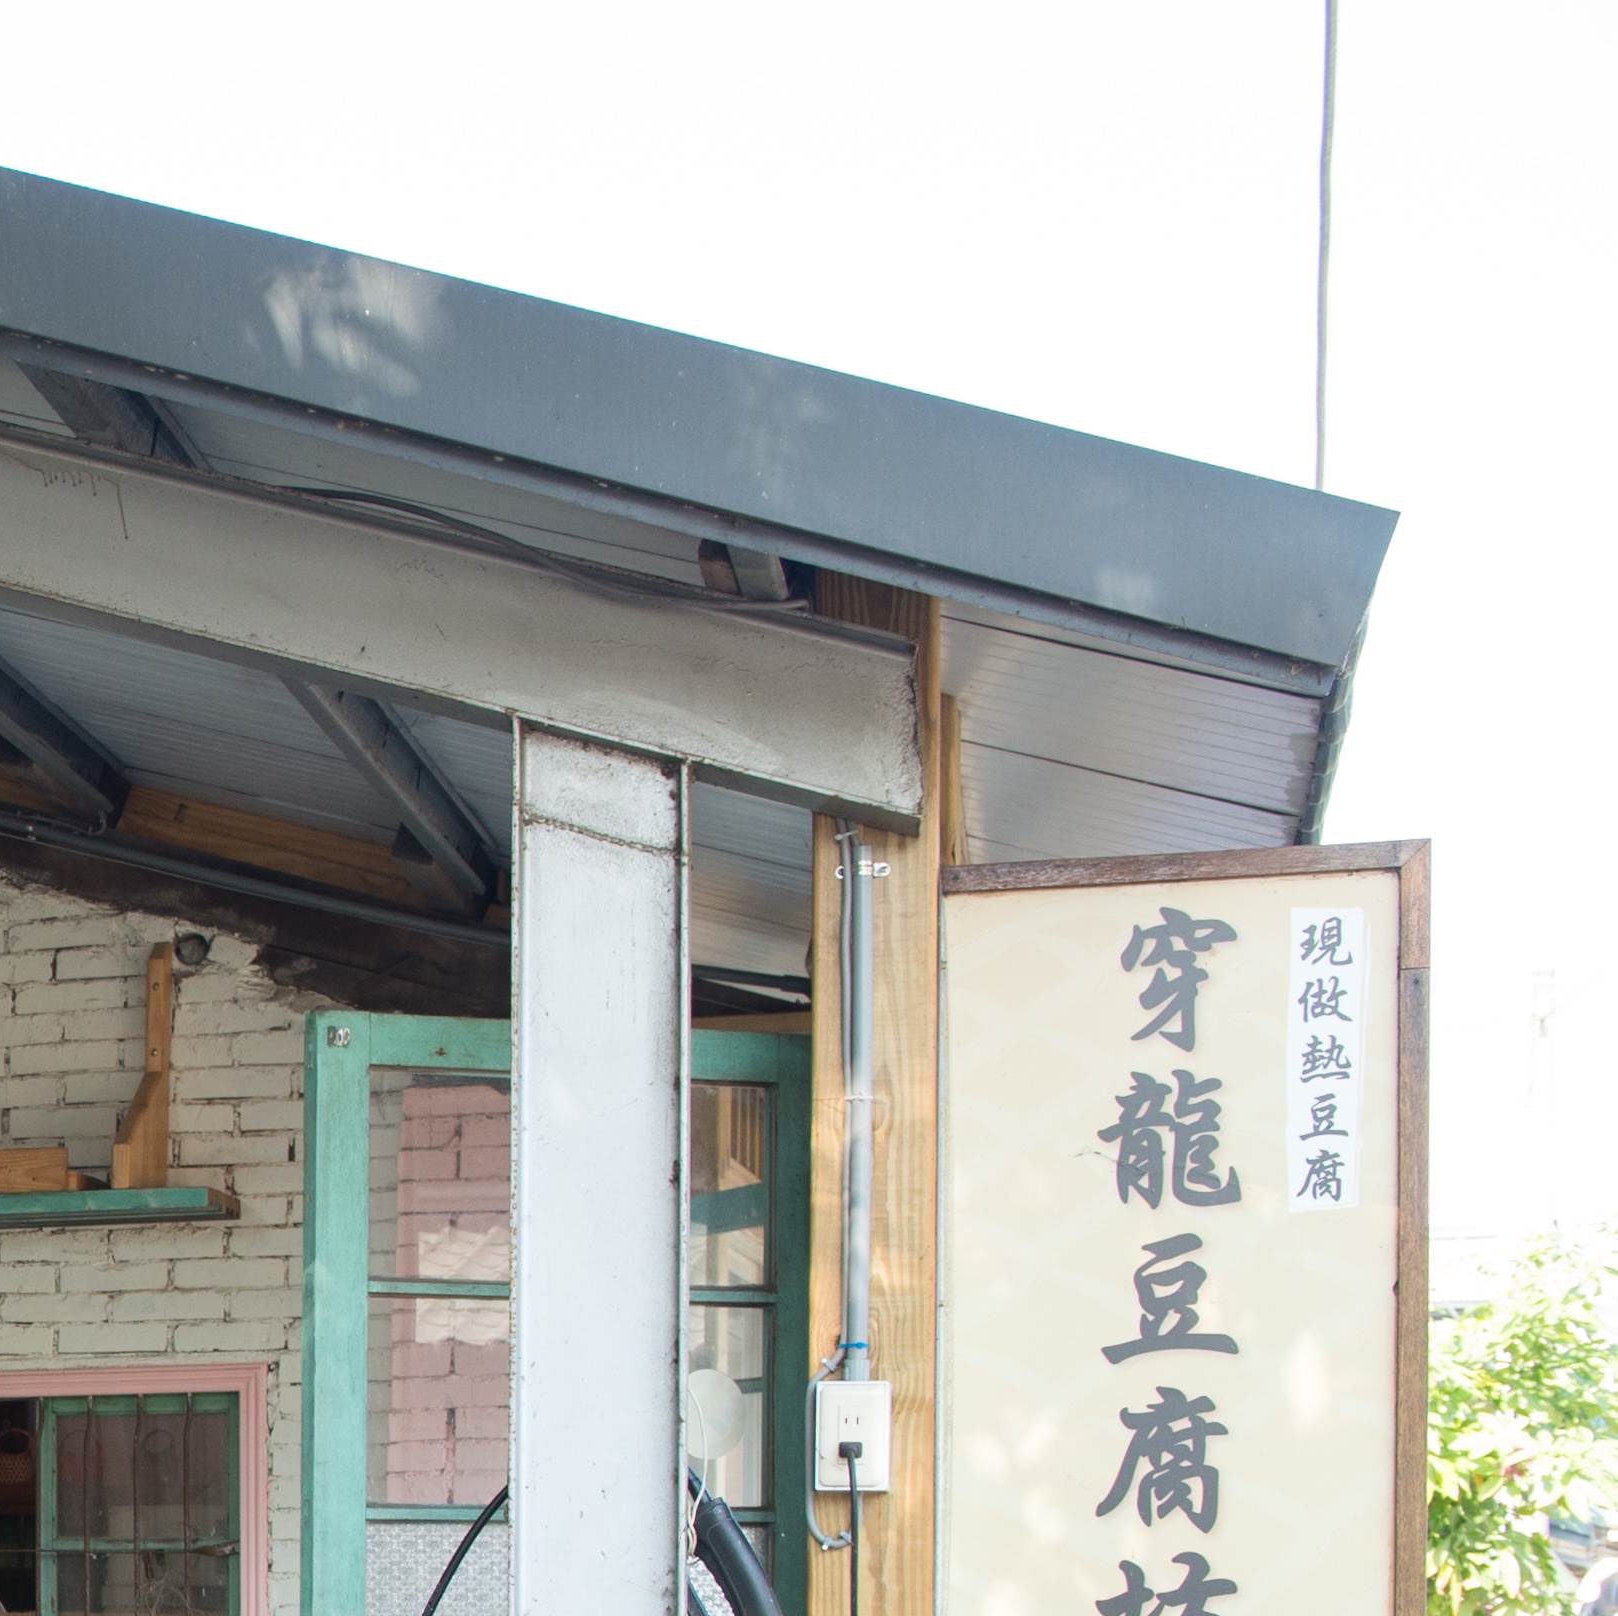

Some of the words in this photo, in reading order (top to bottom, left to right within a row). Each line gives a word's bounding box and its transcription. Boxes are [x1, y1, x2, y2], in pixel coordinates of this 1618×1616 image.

[1297, 917, 1353, 1204] 現做熱豆腐
